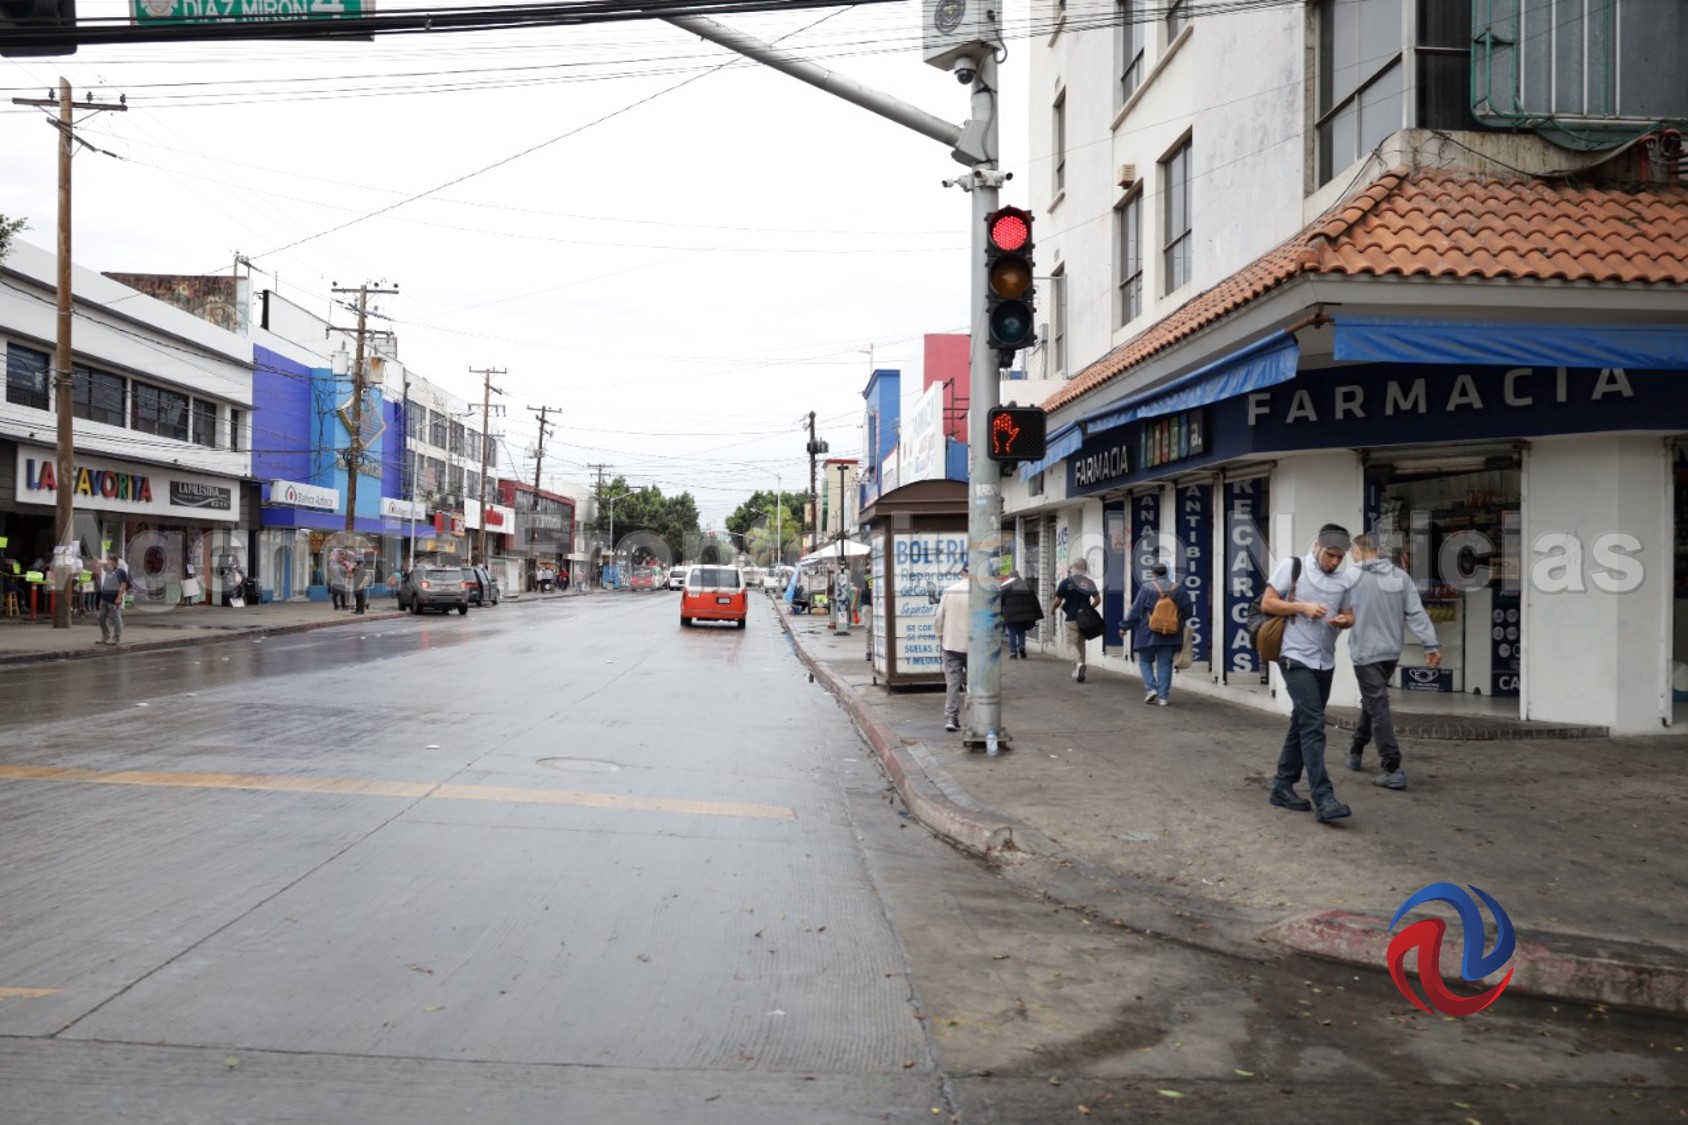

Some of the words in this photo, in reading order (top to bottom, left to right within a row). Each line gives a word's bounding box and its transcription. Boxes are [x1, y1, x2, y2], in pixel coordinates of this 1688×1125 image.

[1247, 366, 1635, 426] FARMACIA
[26, 458, 57, 491] LA
[73, 465, 154, 502] AVORITA
[1075, 445, 1129, 487] FARMACIA
[896, 539, 968, 565] BOLERI
[1140, 496, 1155, 581] ANALGE
[1231, 480, 1254, 673] RECARGAS
[905, 645, 932, 653] SUELAS
